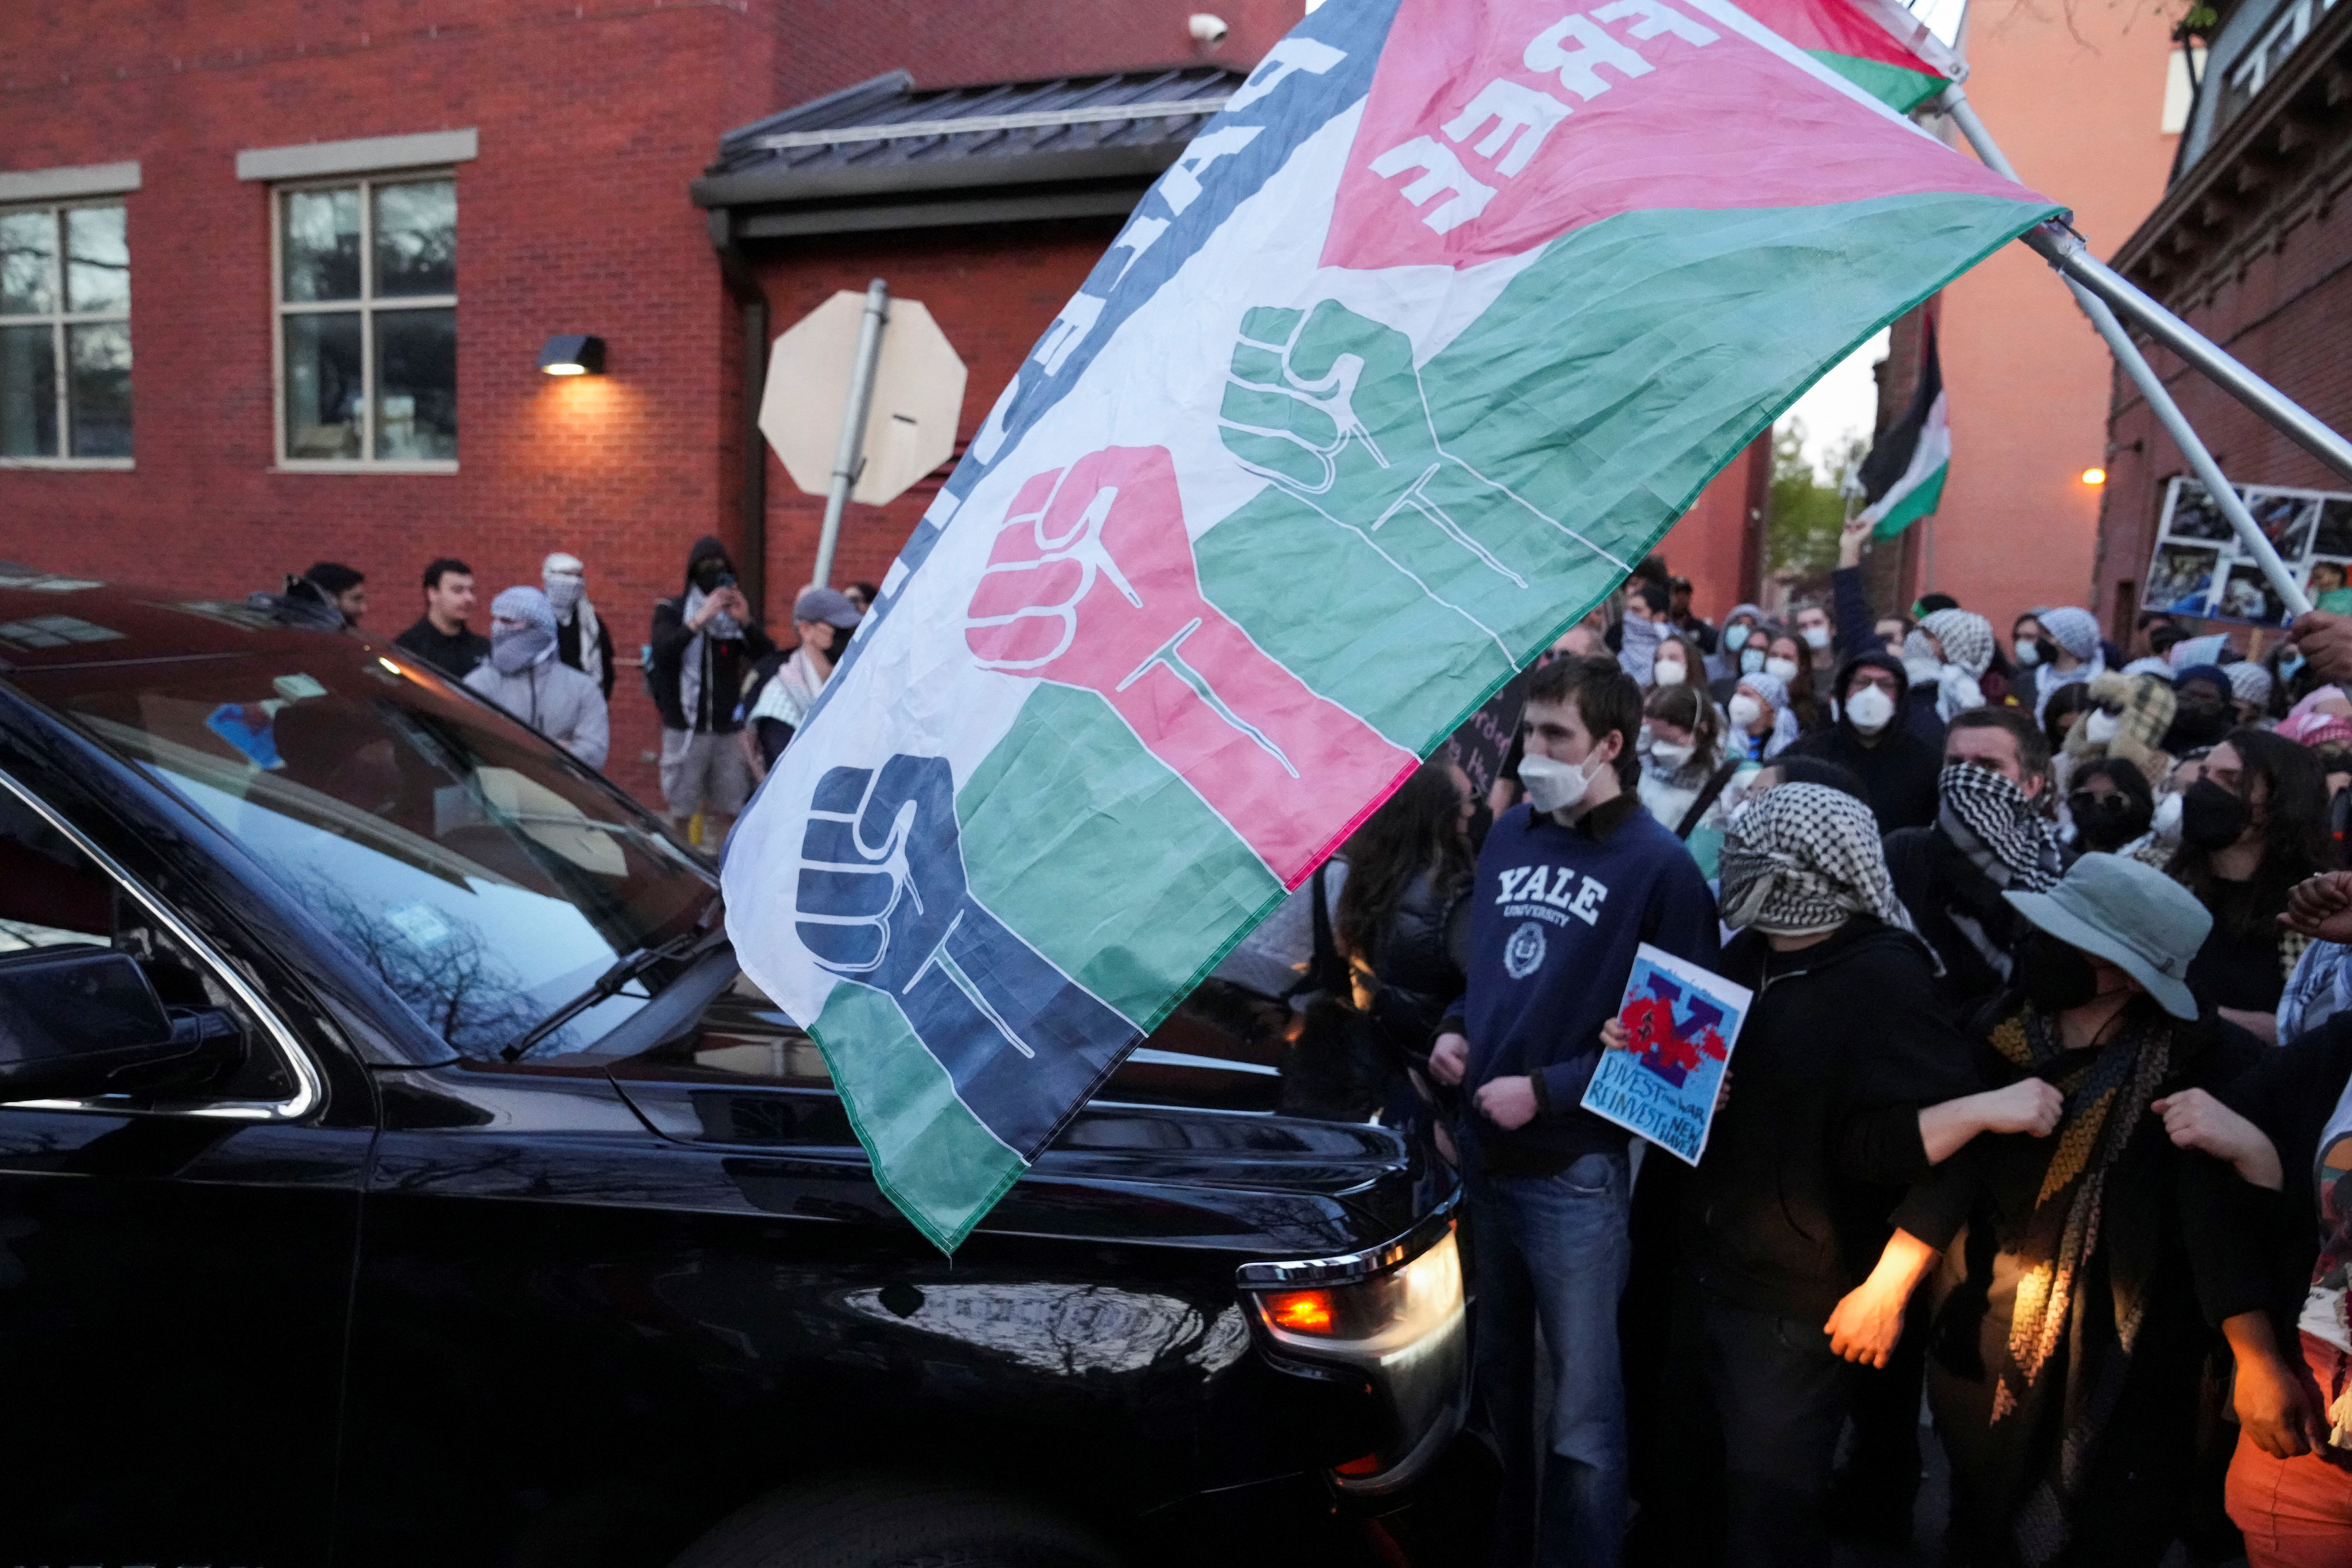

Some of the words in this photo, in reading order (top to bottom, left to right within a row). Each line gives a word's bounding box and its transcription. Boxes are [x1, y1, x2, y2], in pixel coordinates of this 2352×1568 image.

[1494, 864, 1609, 926] YALE
[1503, 903, 1570, 927] UNIVERSITY
[1602, 1056, 1668, 1103] DIVEST
[1588, 1080, 1667, 1133] REINVEST
[1670, 1116, 1705, 1142] NEW
